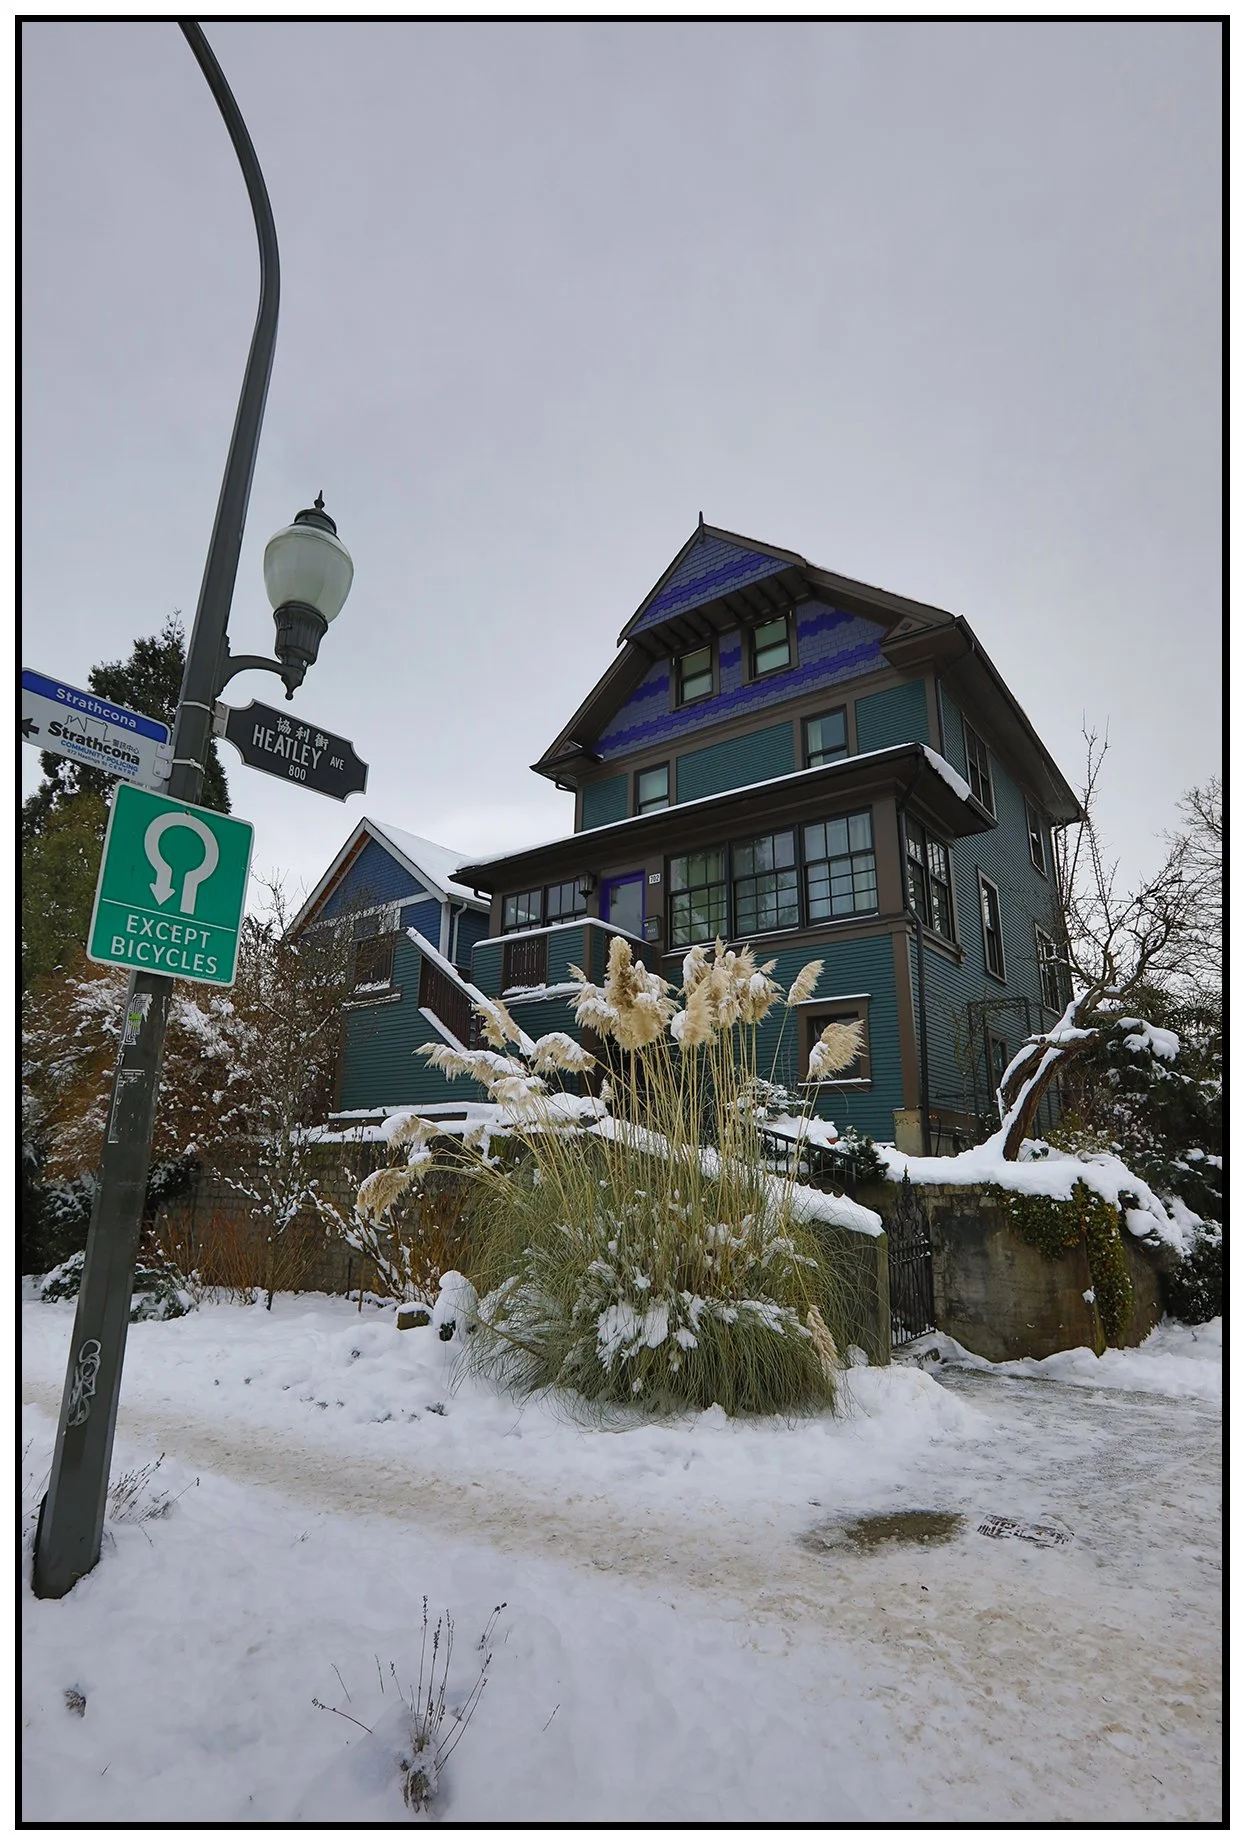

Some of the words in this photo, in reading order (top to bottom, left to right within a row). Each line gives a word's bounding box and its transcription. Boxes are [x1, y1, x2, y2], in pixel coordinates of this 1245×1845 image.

[56, 688, 137, 729] Strathcona
[47, 721, 140, 765] Strathcona
[60, 740, 106, 760] COMMUNITY
[106, 756, 139, 772] POLICING
[252, 724, 322, 769] HEATLEY
[330, 756, 345, 771] AVE
[108, 763, 136, 776] CENTRE
[288, 764, 306, 780] 800
[650, 874, 660, 883] 702
[126, 914, 211, 949] EXCEPT
[110, 936, 218, 974] BICYCLES
